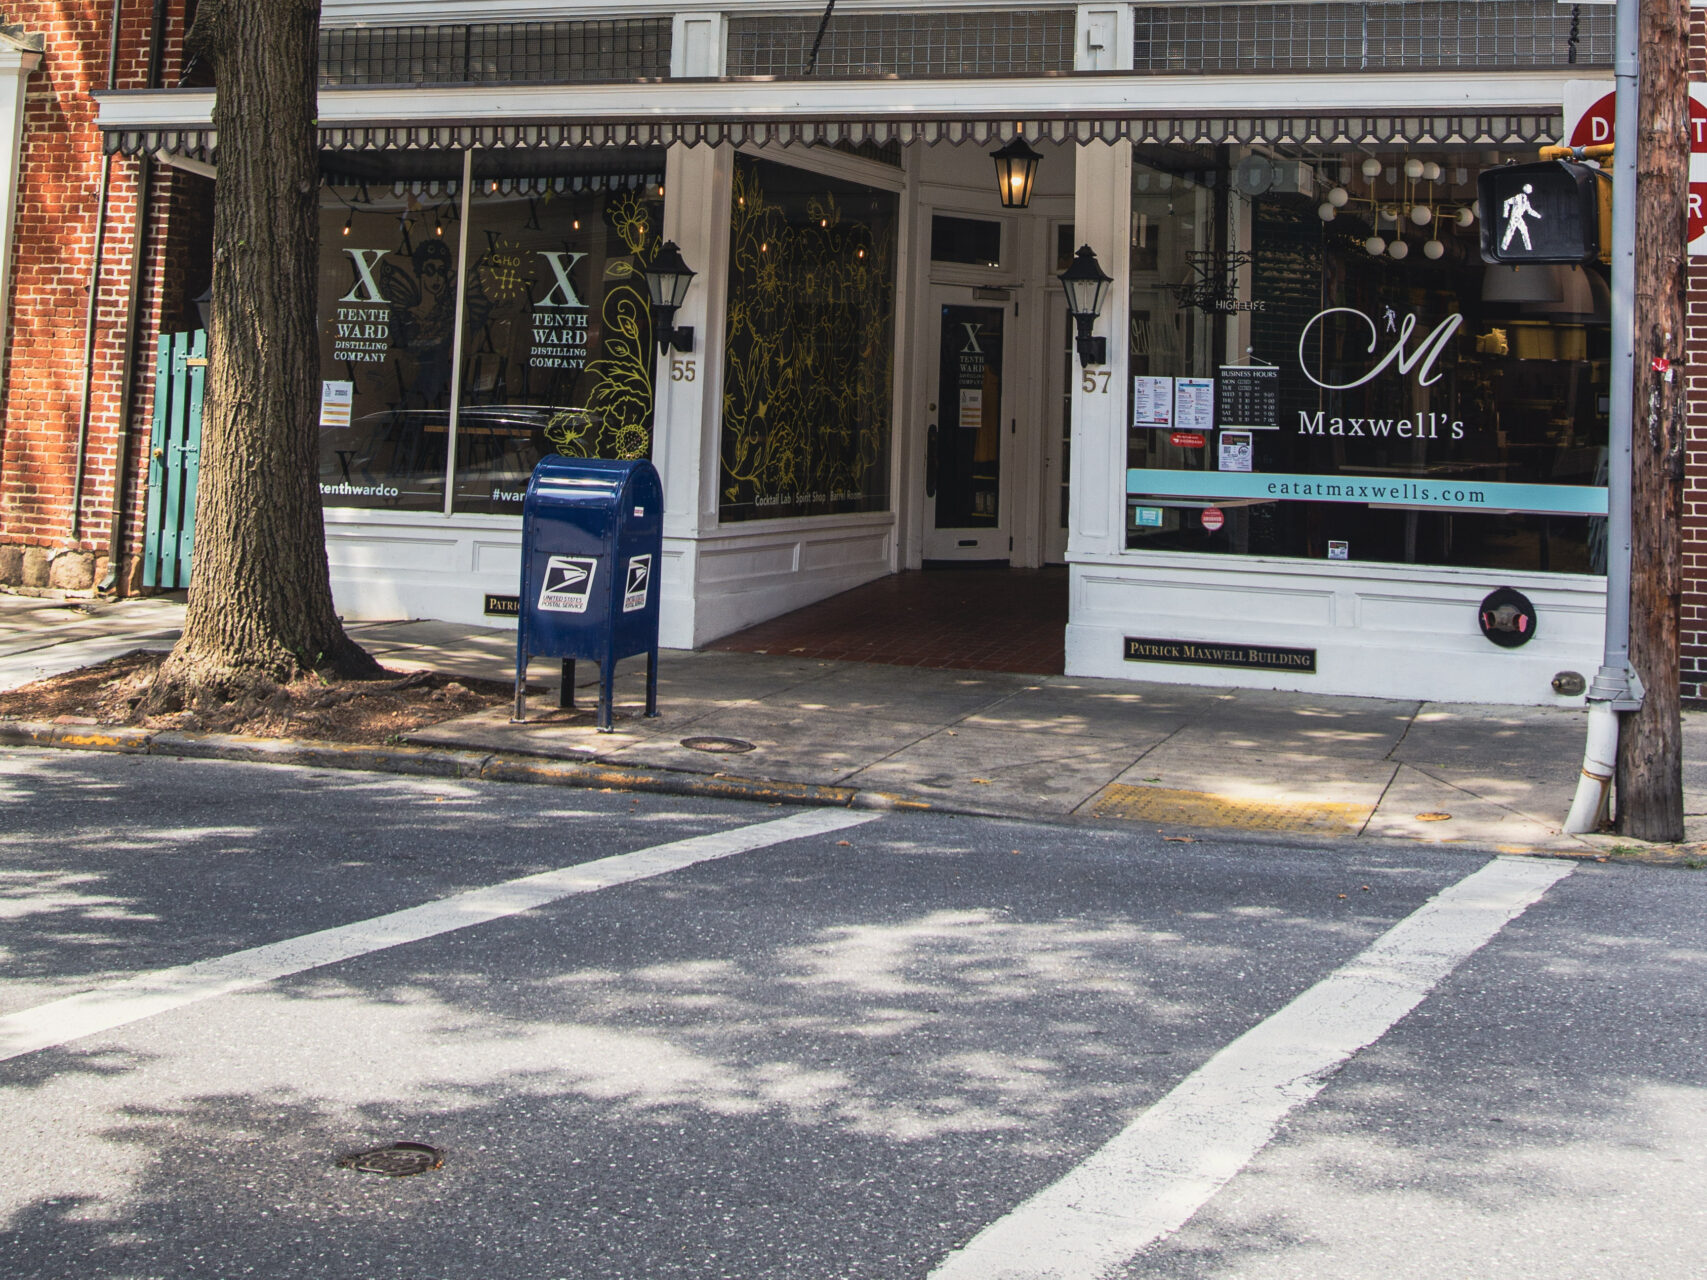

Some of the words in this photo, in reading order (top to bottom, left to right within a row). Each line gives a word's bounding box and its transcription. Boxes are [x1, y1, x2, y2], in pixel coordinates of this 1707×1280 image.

[1591, 116, 1616, 142] D
[338, 248, 392, 303] X
[533, 251, 590, 308] X
[337, 308, 390, 322] TENTH
[532, 313, 588, 327] TENTH
[336, 323, 389, 339] WARD
[531, 328, 588, 345] WARD
[960, 322, 985, 353] X
[335, 340, 388, 350] DISTILLING
[530, 346, 587, 357] DISTILLING
[333, 351, 386, 362] COMPANY
[529, 357, 586, 369] COMPANY
[671, 359, 697, 382] 55
[960, 364, 984, 373] WARD
[1081, 369, 1112, 394] 57
[1297, 410, 1464, 439] Maxwell's
[492, 488, 526, 502] #war
[755, 493, 780, 507] Cocktail
[780, 492, 791, 505] Lab
[812, 490, 826, 504] Shop
[1267, 482, 1485, 503] eatatmaxwells.com
[490, 598, 520, 611] PATRI
